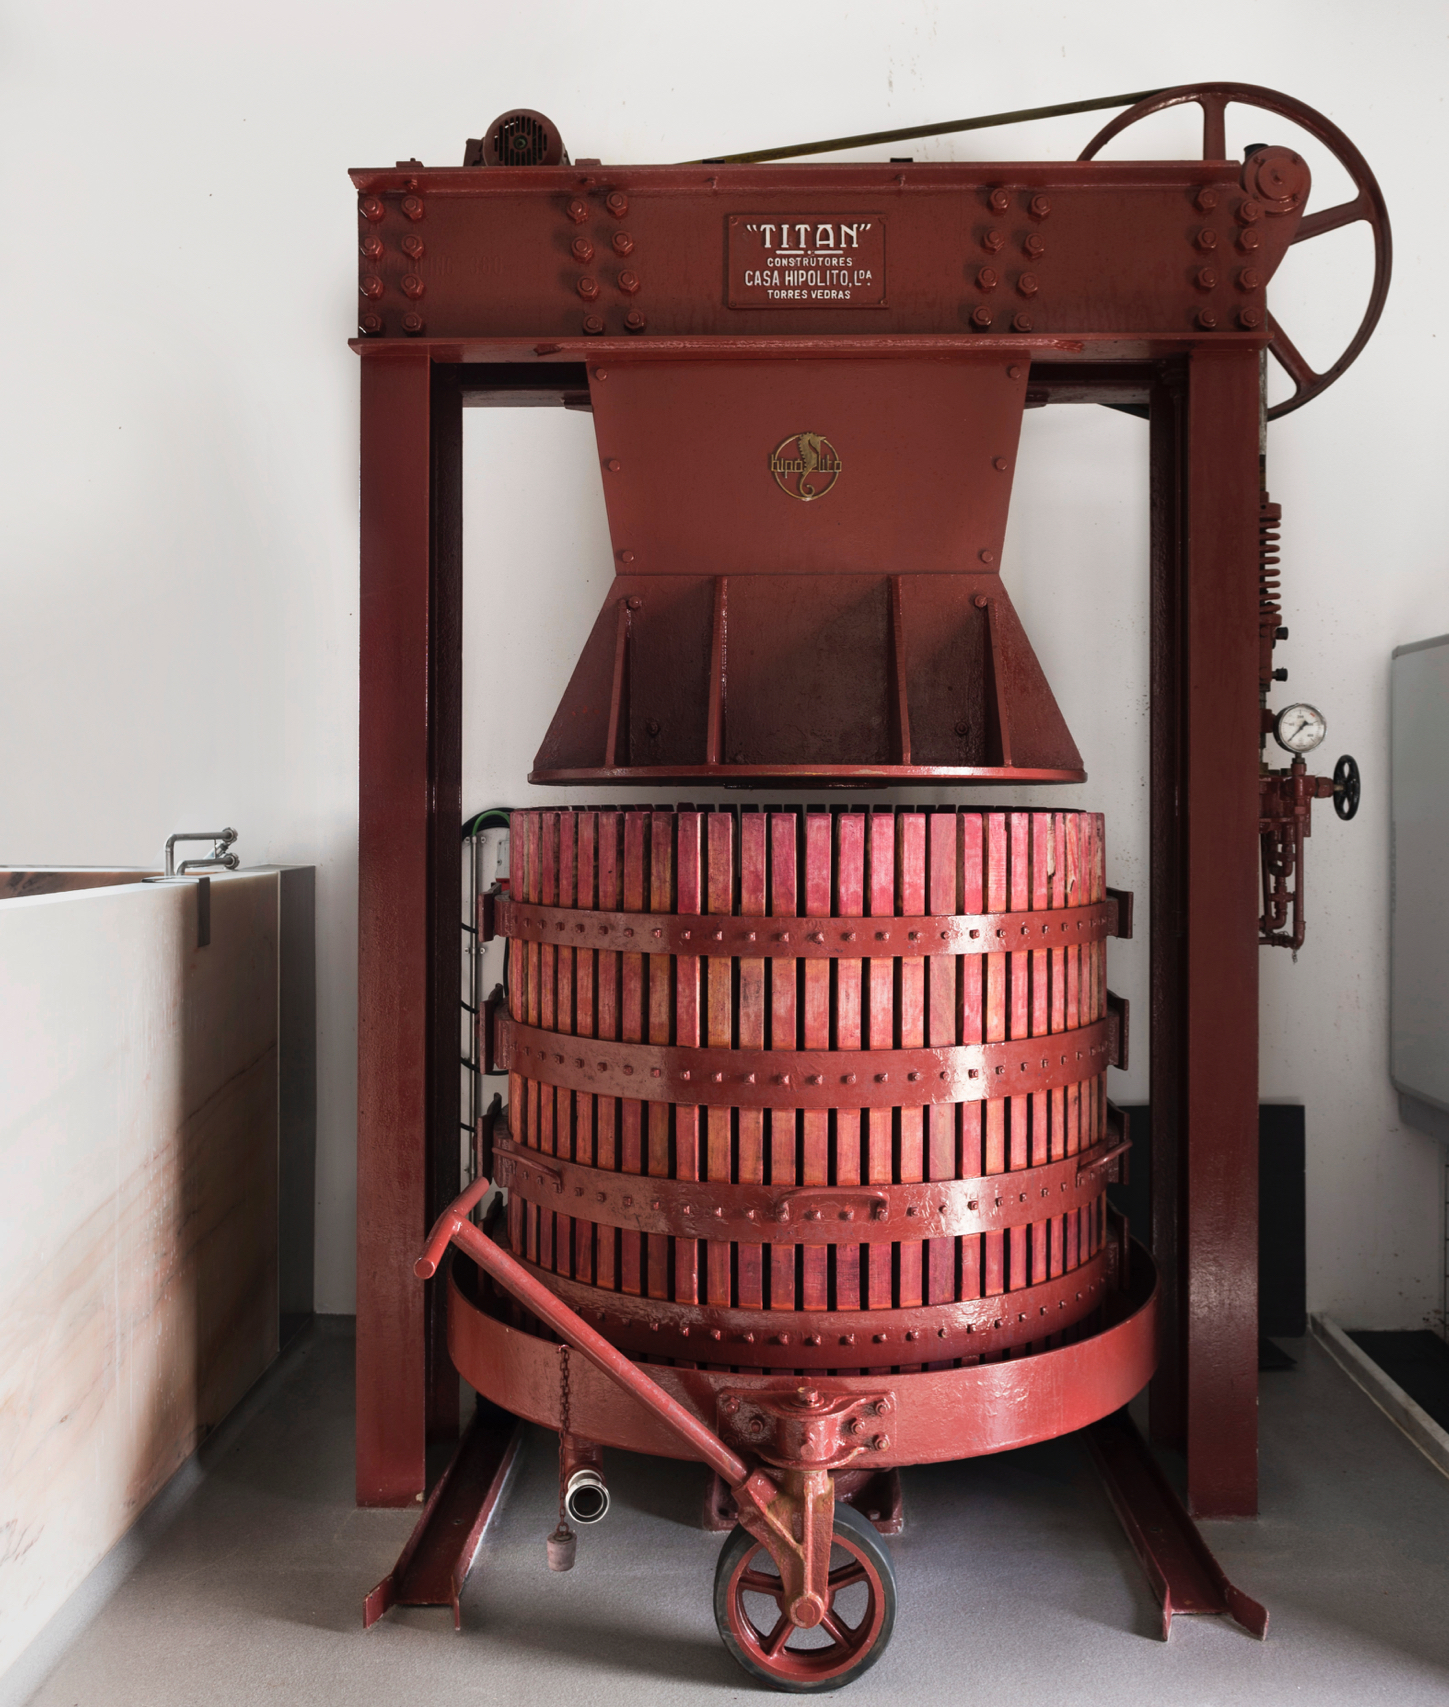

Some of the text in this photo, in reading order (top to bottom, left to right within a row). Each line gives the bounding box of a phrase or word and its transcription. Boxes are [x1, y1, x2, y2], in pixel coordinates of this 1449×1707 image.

[767, 257, 853, 267] CONSTRUTORES
[745, 270, 780, 287] CASA
[767, 289, 851, 299] TORRES VEDRAS
